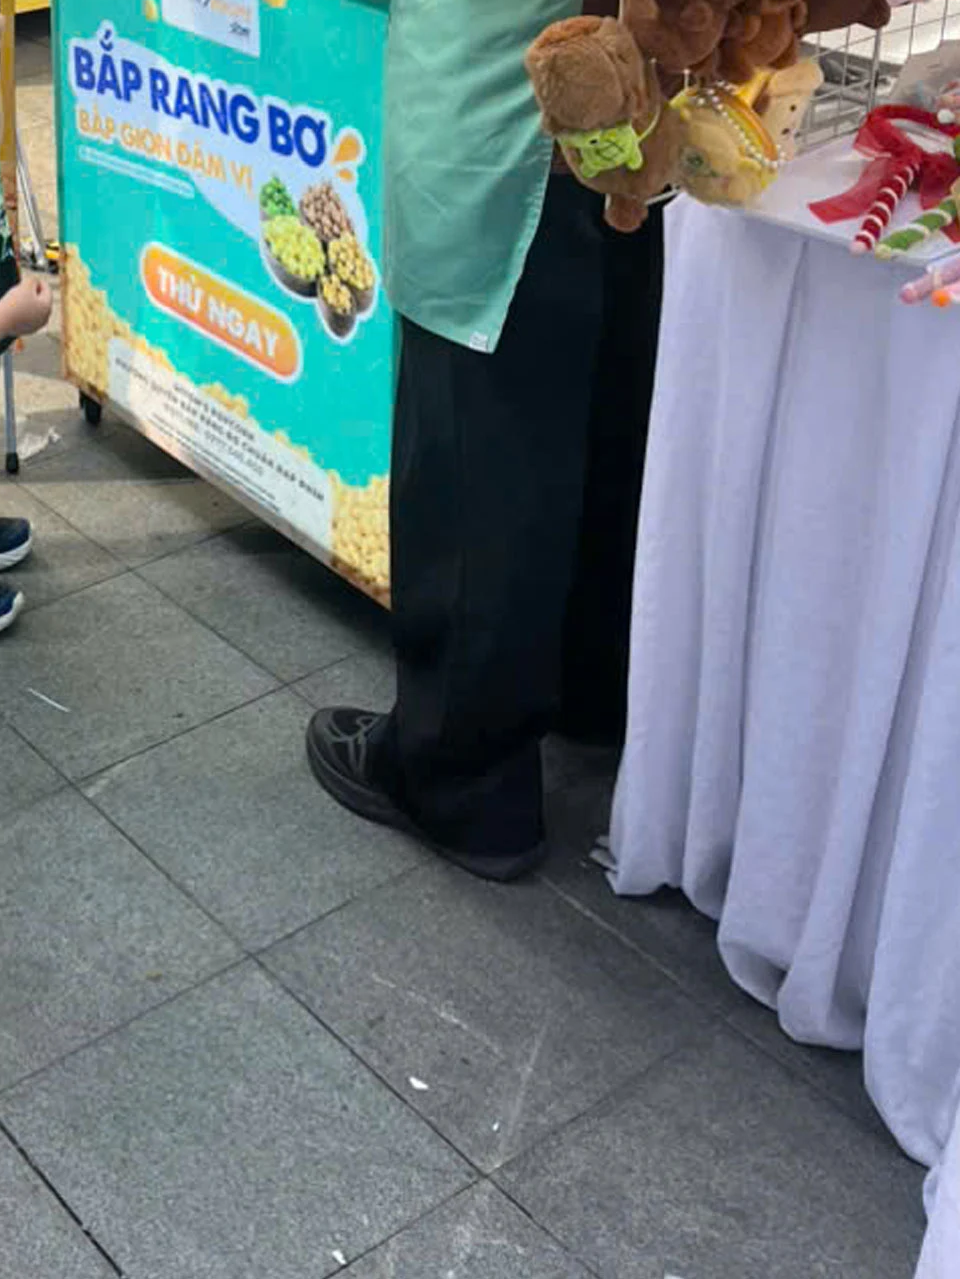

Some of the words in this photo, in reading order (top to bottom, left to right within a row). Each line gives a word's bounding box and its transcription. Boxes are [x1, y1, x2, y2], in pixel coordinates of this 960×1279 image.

[73, 29, 142, 102] BẮP
[150, 67, 260, 144] RANG
[267, 104, 327, 167] BƠ
[208, 295, 279, 357] NGAY
